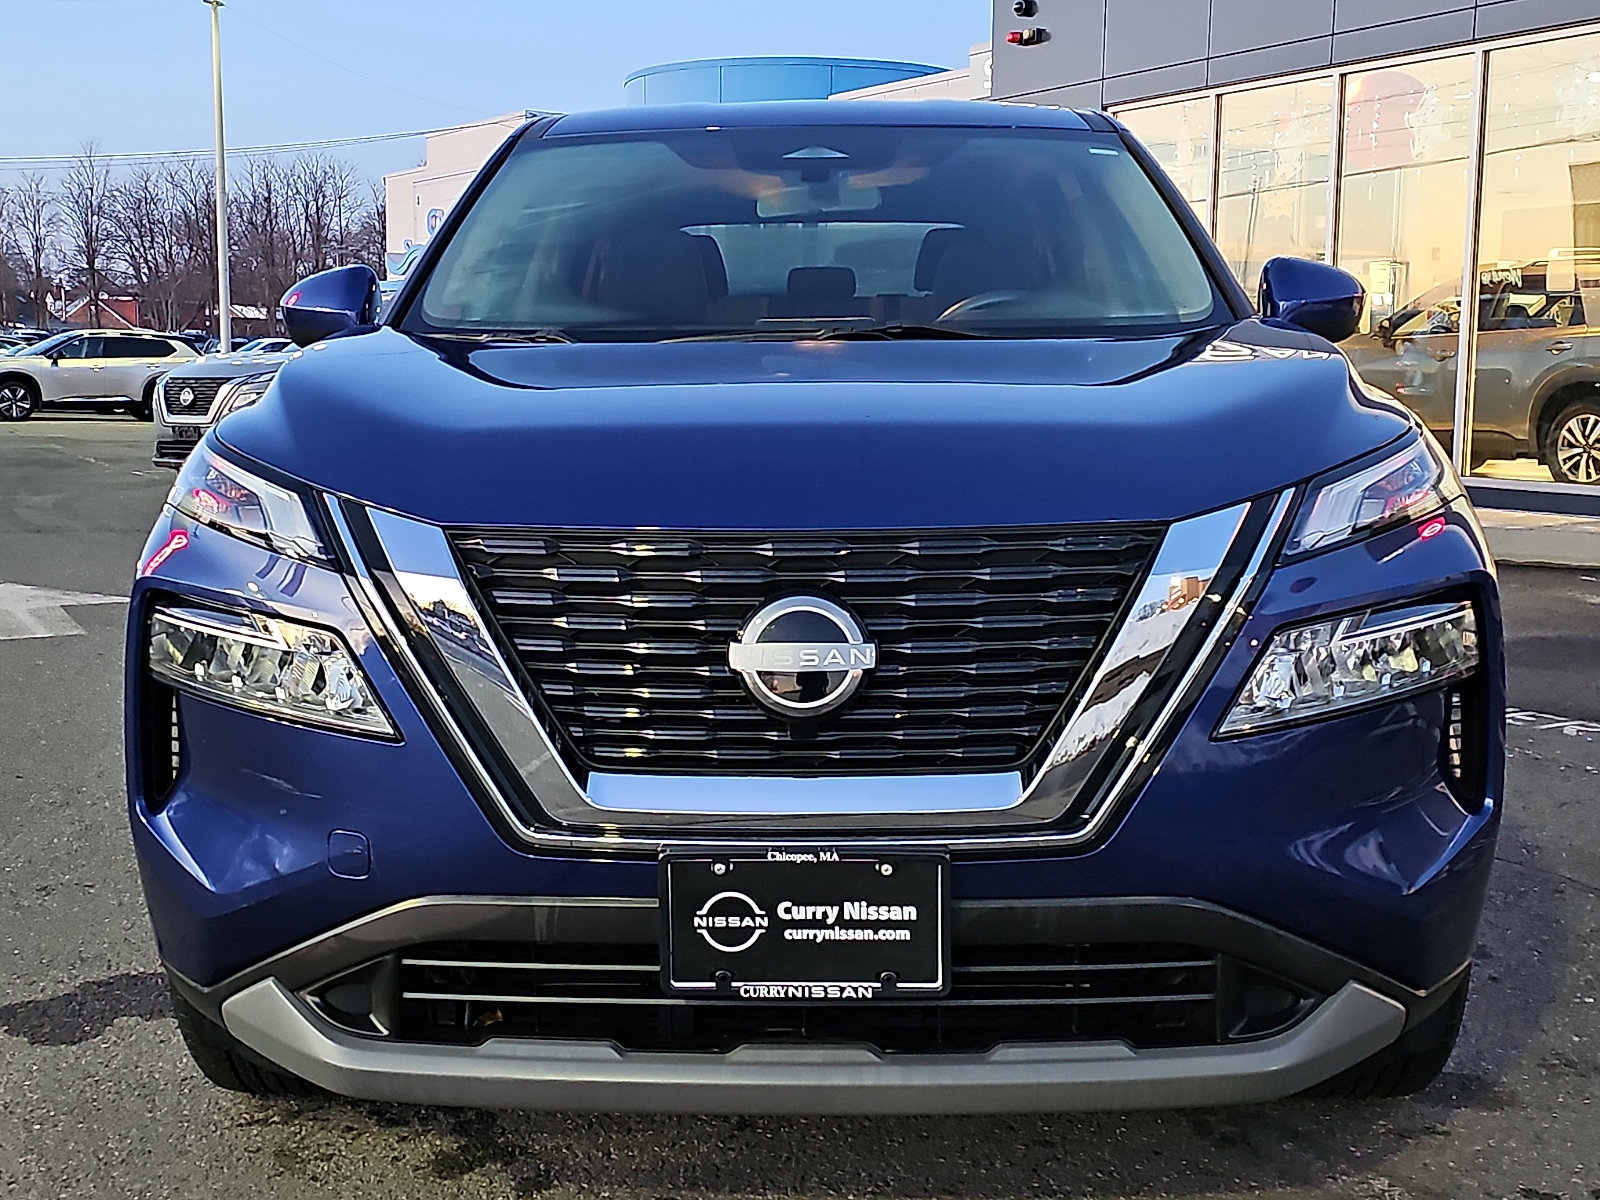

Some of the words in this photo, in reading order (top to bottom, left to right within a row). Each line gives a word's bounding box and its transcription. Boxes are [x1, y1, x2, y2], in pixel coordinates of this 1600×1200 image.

[819, 851, 840, 862] MA
[777, 901, 840, 925] Curry
[843, 900, 918, 921] Nissan
[693, 916, 769, 928] NISSAN
[783, 926, 911, 943] currynissan.com
